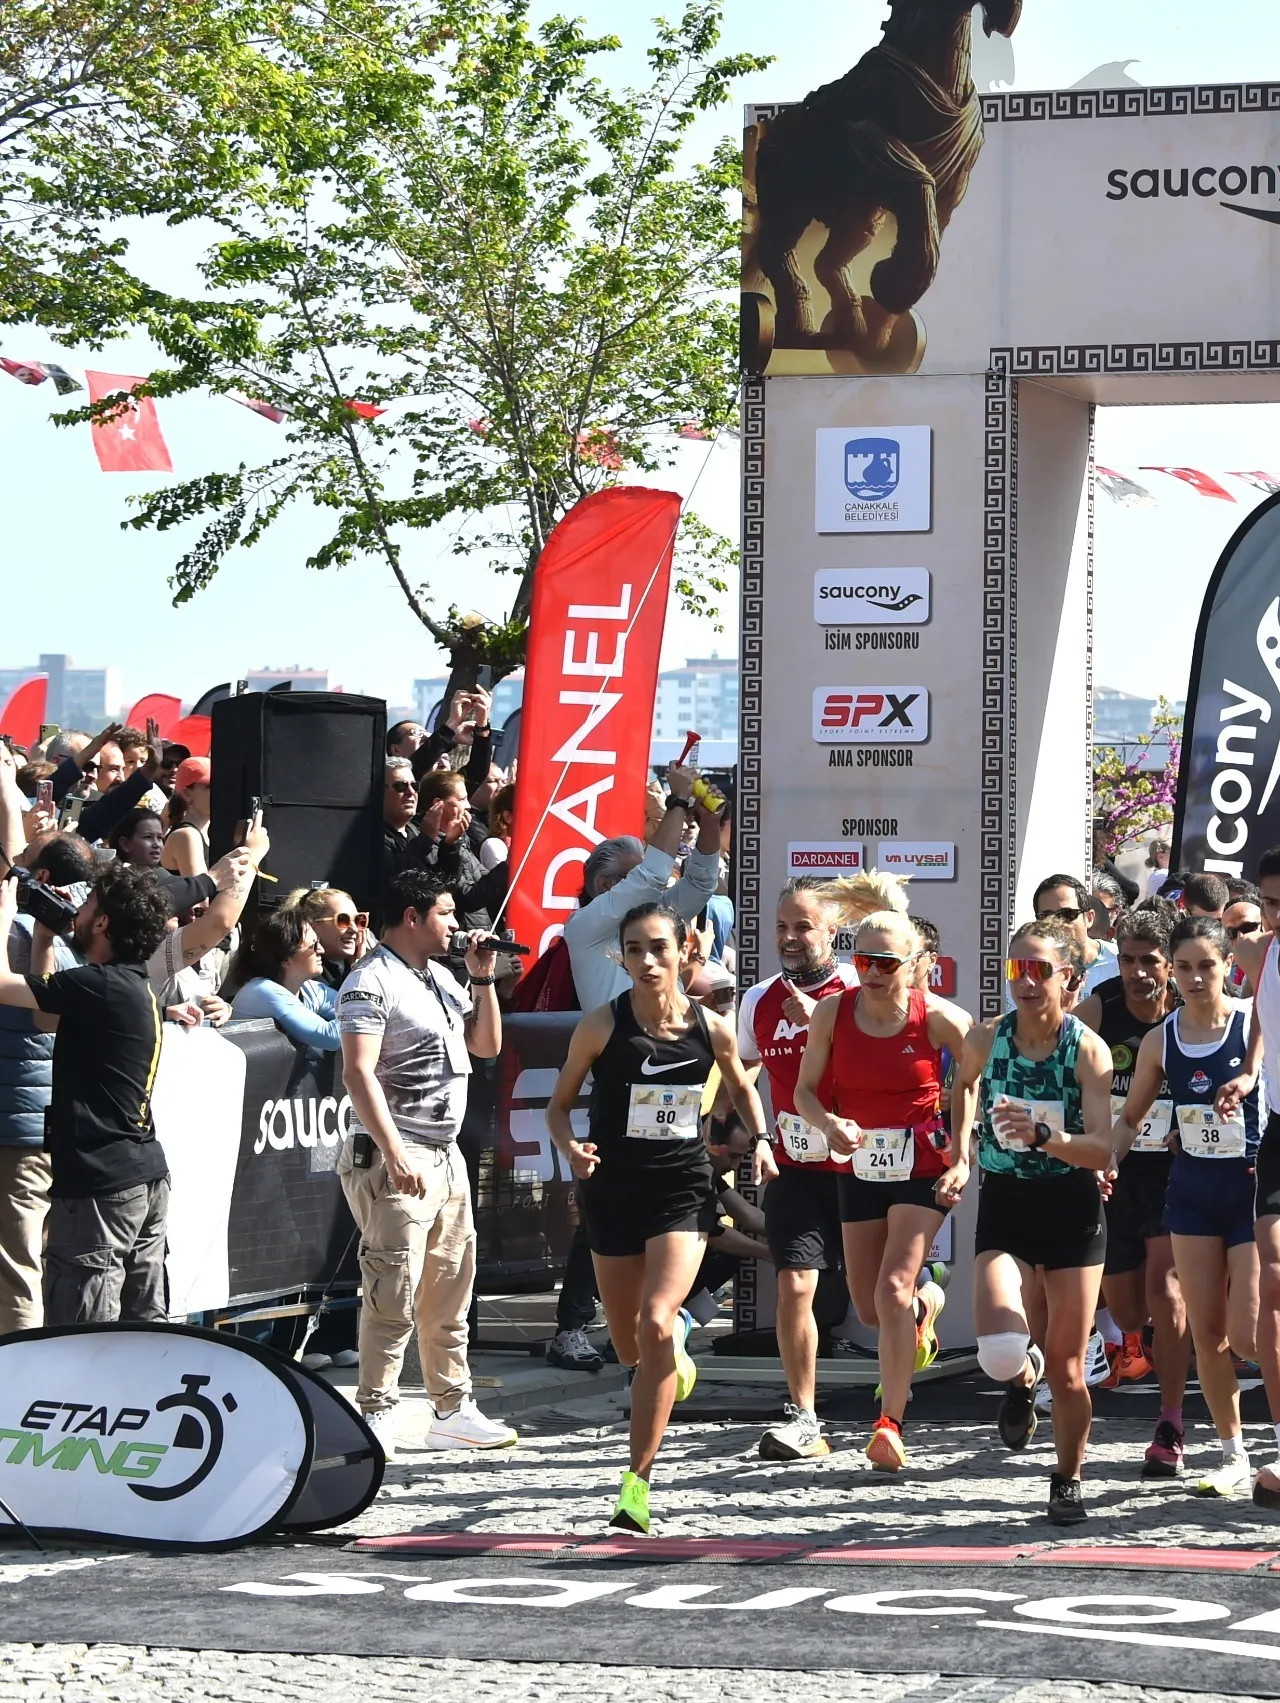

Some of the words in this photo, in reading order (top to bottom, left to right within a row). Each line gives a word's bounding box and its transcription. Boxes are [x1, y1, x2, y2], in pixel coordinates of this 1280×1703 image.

[844, 501, 899, 512] ÇANAKKALE
[844, 510, 899, 521] BELEDİYESİ
[819, 585, 901, 601] saucony
[825, 629, 851, 650] İSİM
[855, 631, 920, 650] SPONSORU
[820, 693, 921, 727] SPX
[828, 749, 854, 767] ANA
[856, 749, 913, 767] SPONSOR
[841, 818, 899, 836] SPONSOR
[793, 853, 857, 866] DARDANEL
[904, 851, 948, 866] uysal
[656, 1110, 676, 1124] 80
[789, 1135, 809, 1151] 158
[1201, 1128, 1220, 1143] 38
[869, 1152, 894, 1168] 241
[20, 1399, 151, 1437] ETAP
